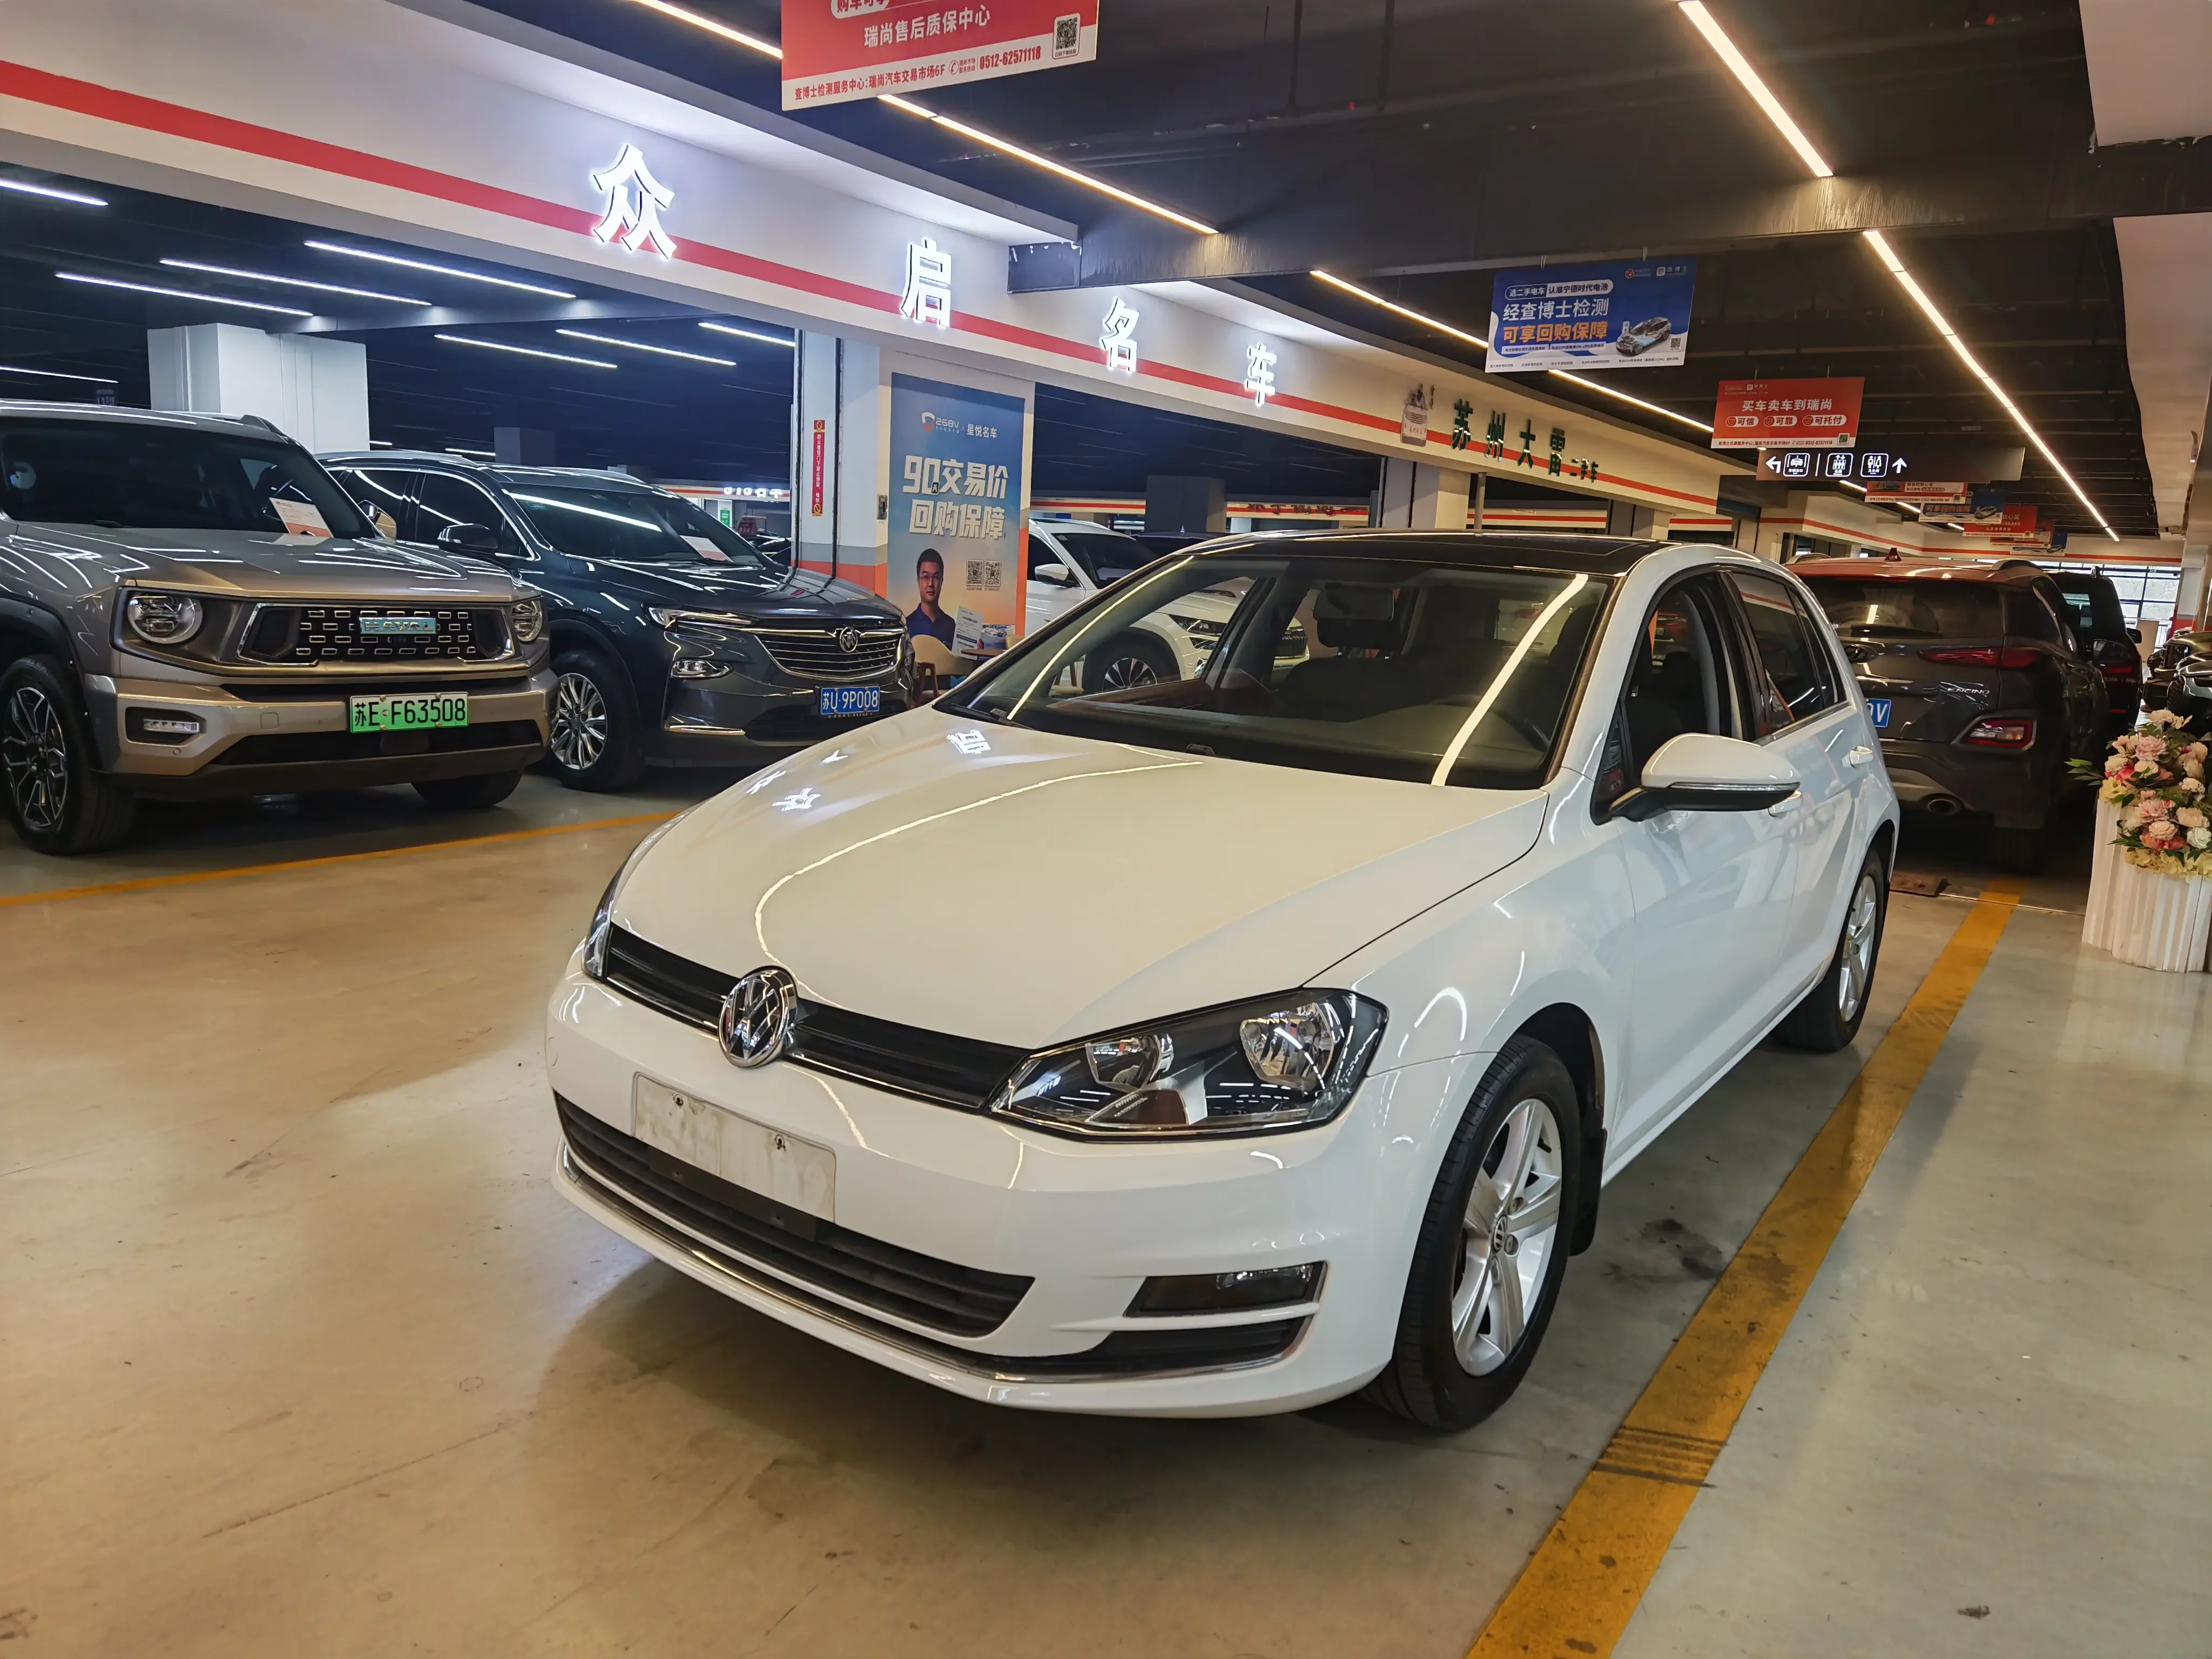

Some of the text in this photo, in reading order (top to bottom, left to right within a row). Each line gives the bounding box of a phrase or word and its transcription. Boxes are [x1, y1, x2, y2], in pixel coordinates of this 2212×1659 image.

[864, 4, 990, 49] 瑞尚售后质保中心
[979, 45, 1041, 70] 0512-62571118
[1509, 282, 1609, 298] 选二手电车 认准宁德时代电池
[1502, 297, 1610, 322] 经查博士检测
[1503, 321, 1608, 344] 可享回购保障
[1742, 398, 1832, 412] 买车卖车到瑞尚
[1737, 416, 1843, 426] 可信 可靠 可托付
[967, 423, 997, 439] 星悦名车
[909, 498, 1006, 541] 回购保障
[365, 621, 436, 631] HAVAL
